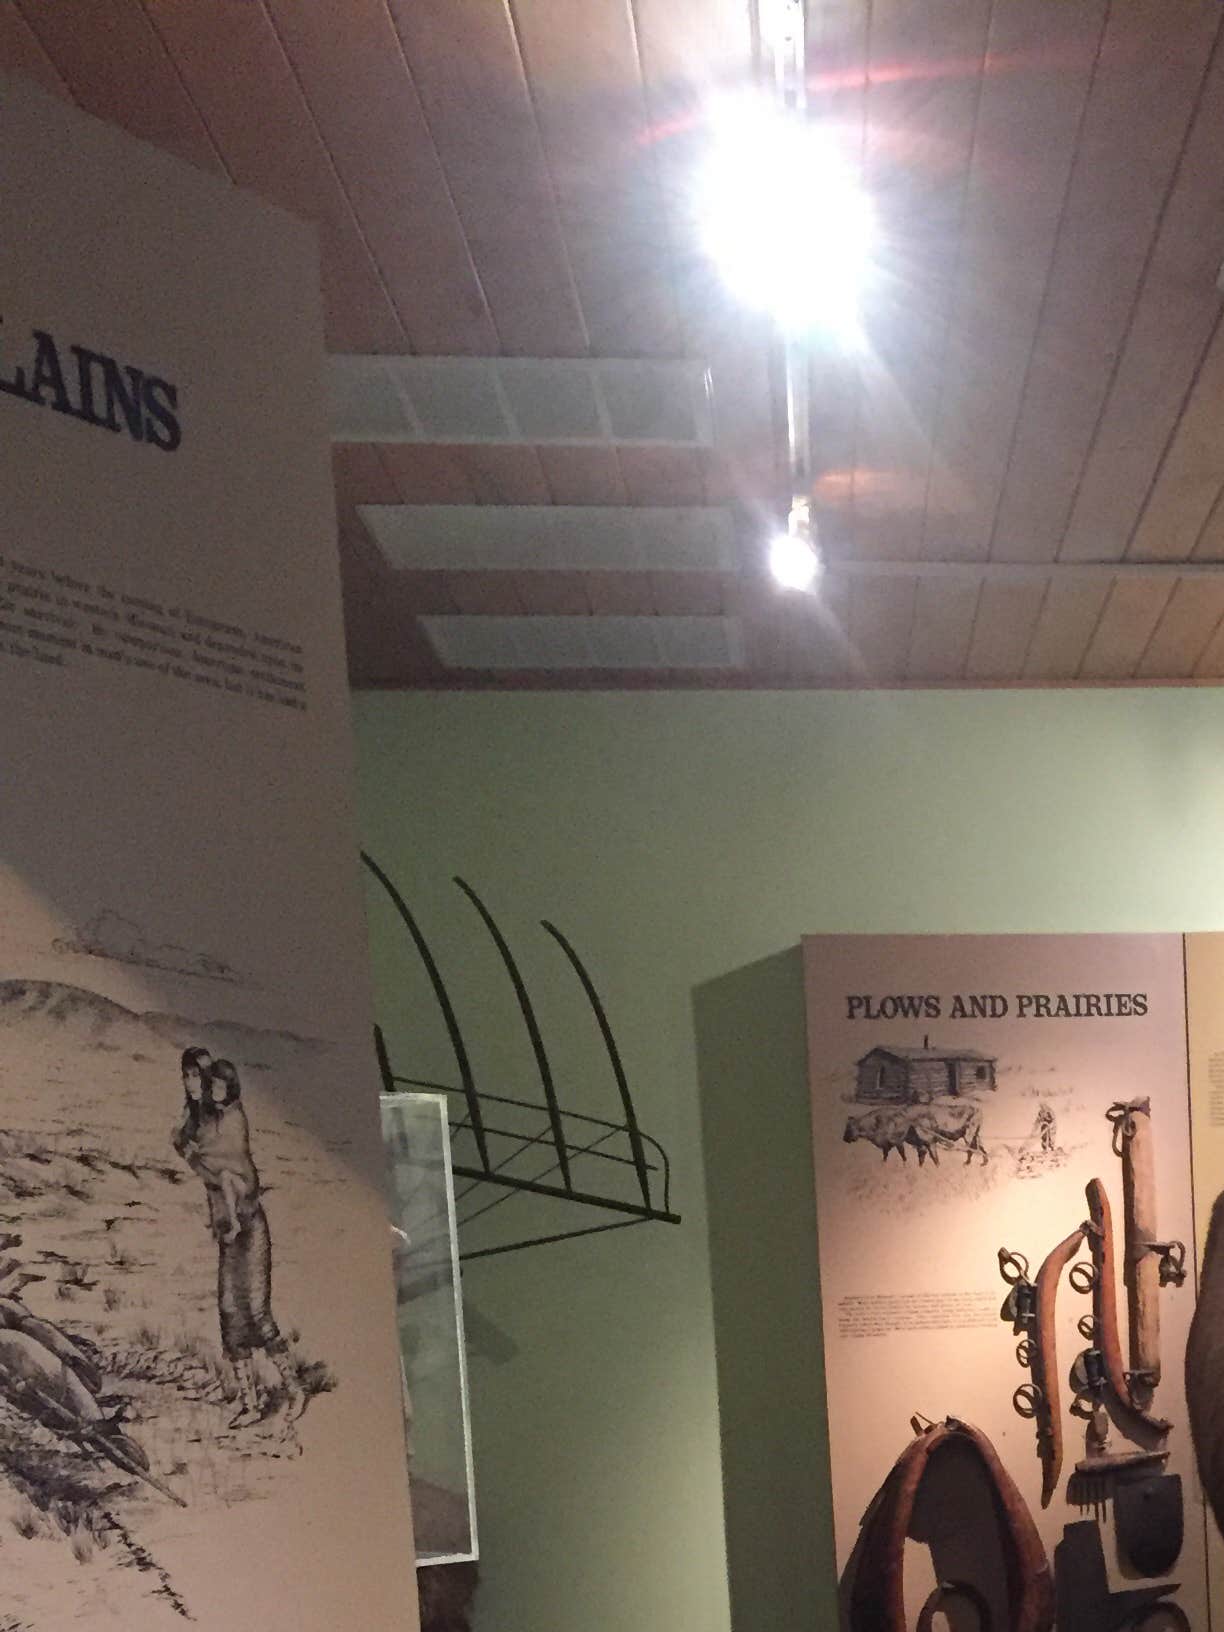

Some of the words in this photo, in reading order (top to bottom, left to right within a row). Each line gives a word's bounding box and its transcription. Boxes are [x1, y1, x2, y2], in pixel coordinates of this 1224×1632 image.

[846, 994, 941, 1020] PLOWS
[950, 994, 1008, 1020] AND
[1016, 993, 1148, 1019] PRAIRIES
